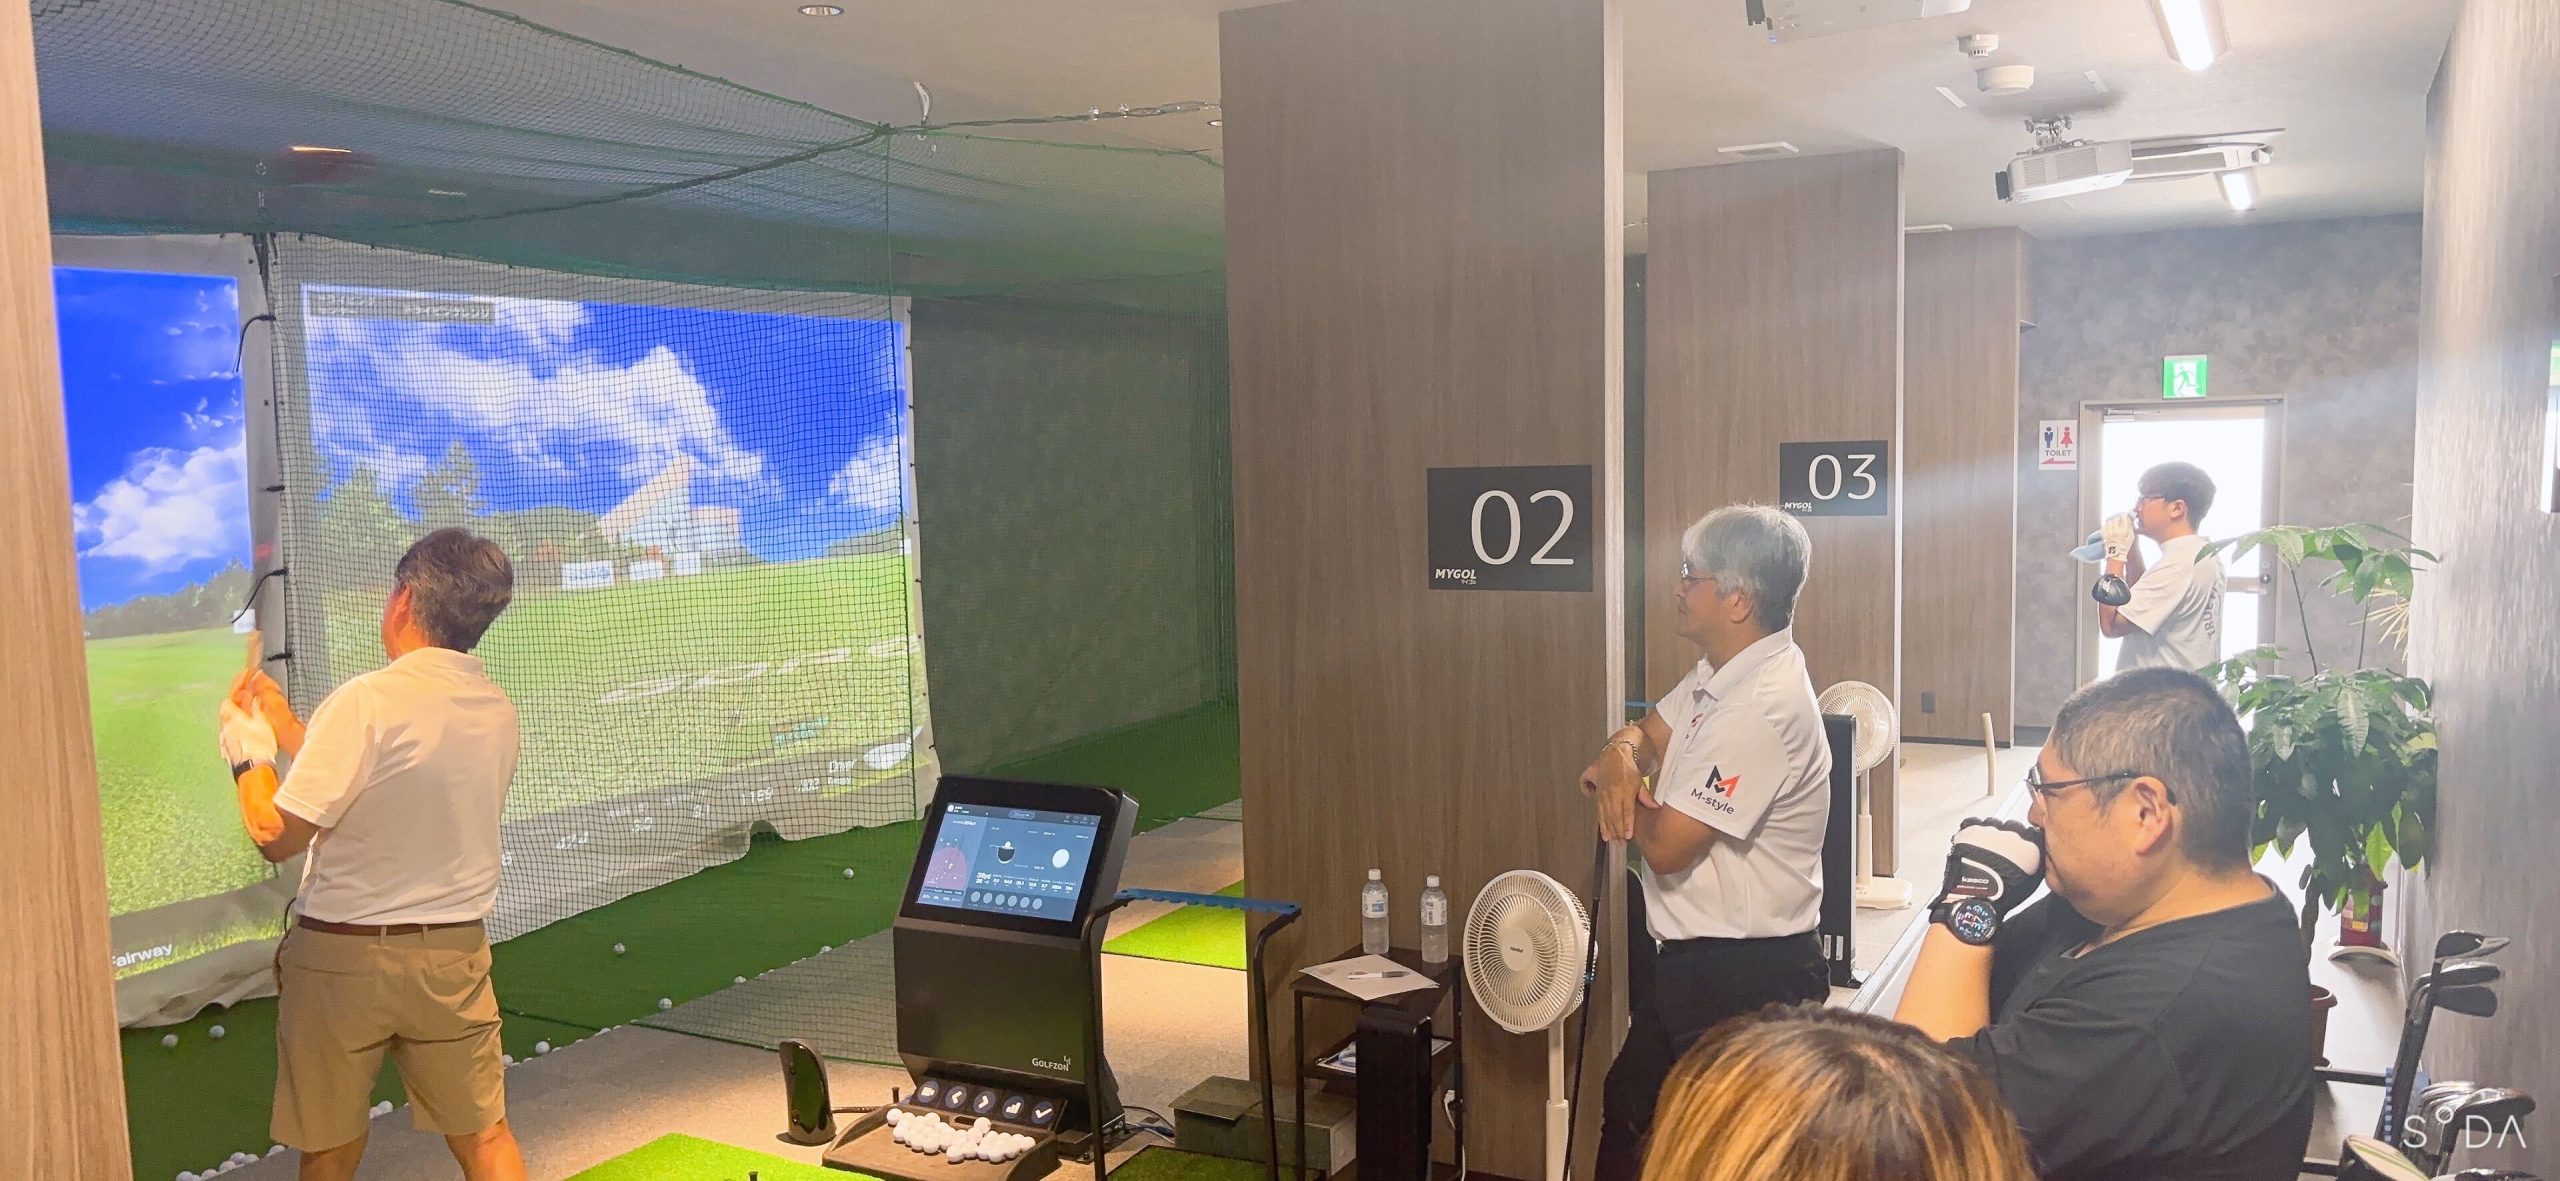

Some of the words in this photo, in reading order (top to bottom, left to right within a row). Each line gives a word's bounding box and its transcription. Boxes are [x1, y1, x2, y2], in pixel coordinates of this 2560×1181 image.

[1808, 454, 1877, 500] 03
[1471, 489, 1575, 566] 02
[1435, 568, 1477, 580] MYGOL
[1691, 788, 1735, 814] M-style
[1962, 876, 1989, 884] kasco
[1032, 1057, 1069, 1071] GOLFZON
